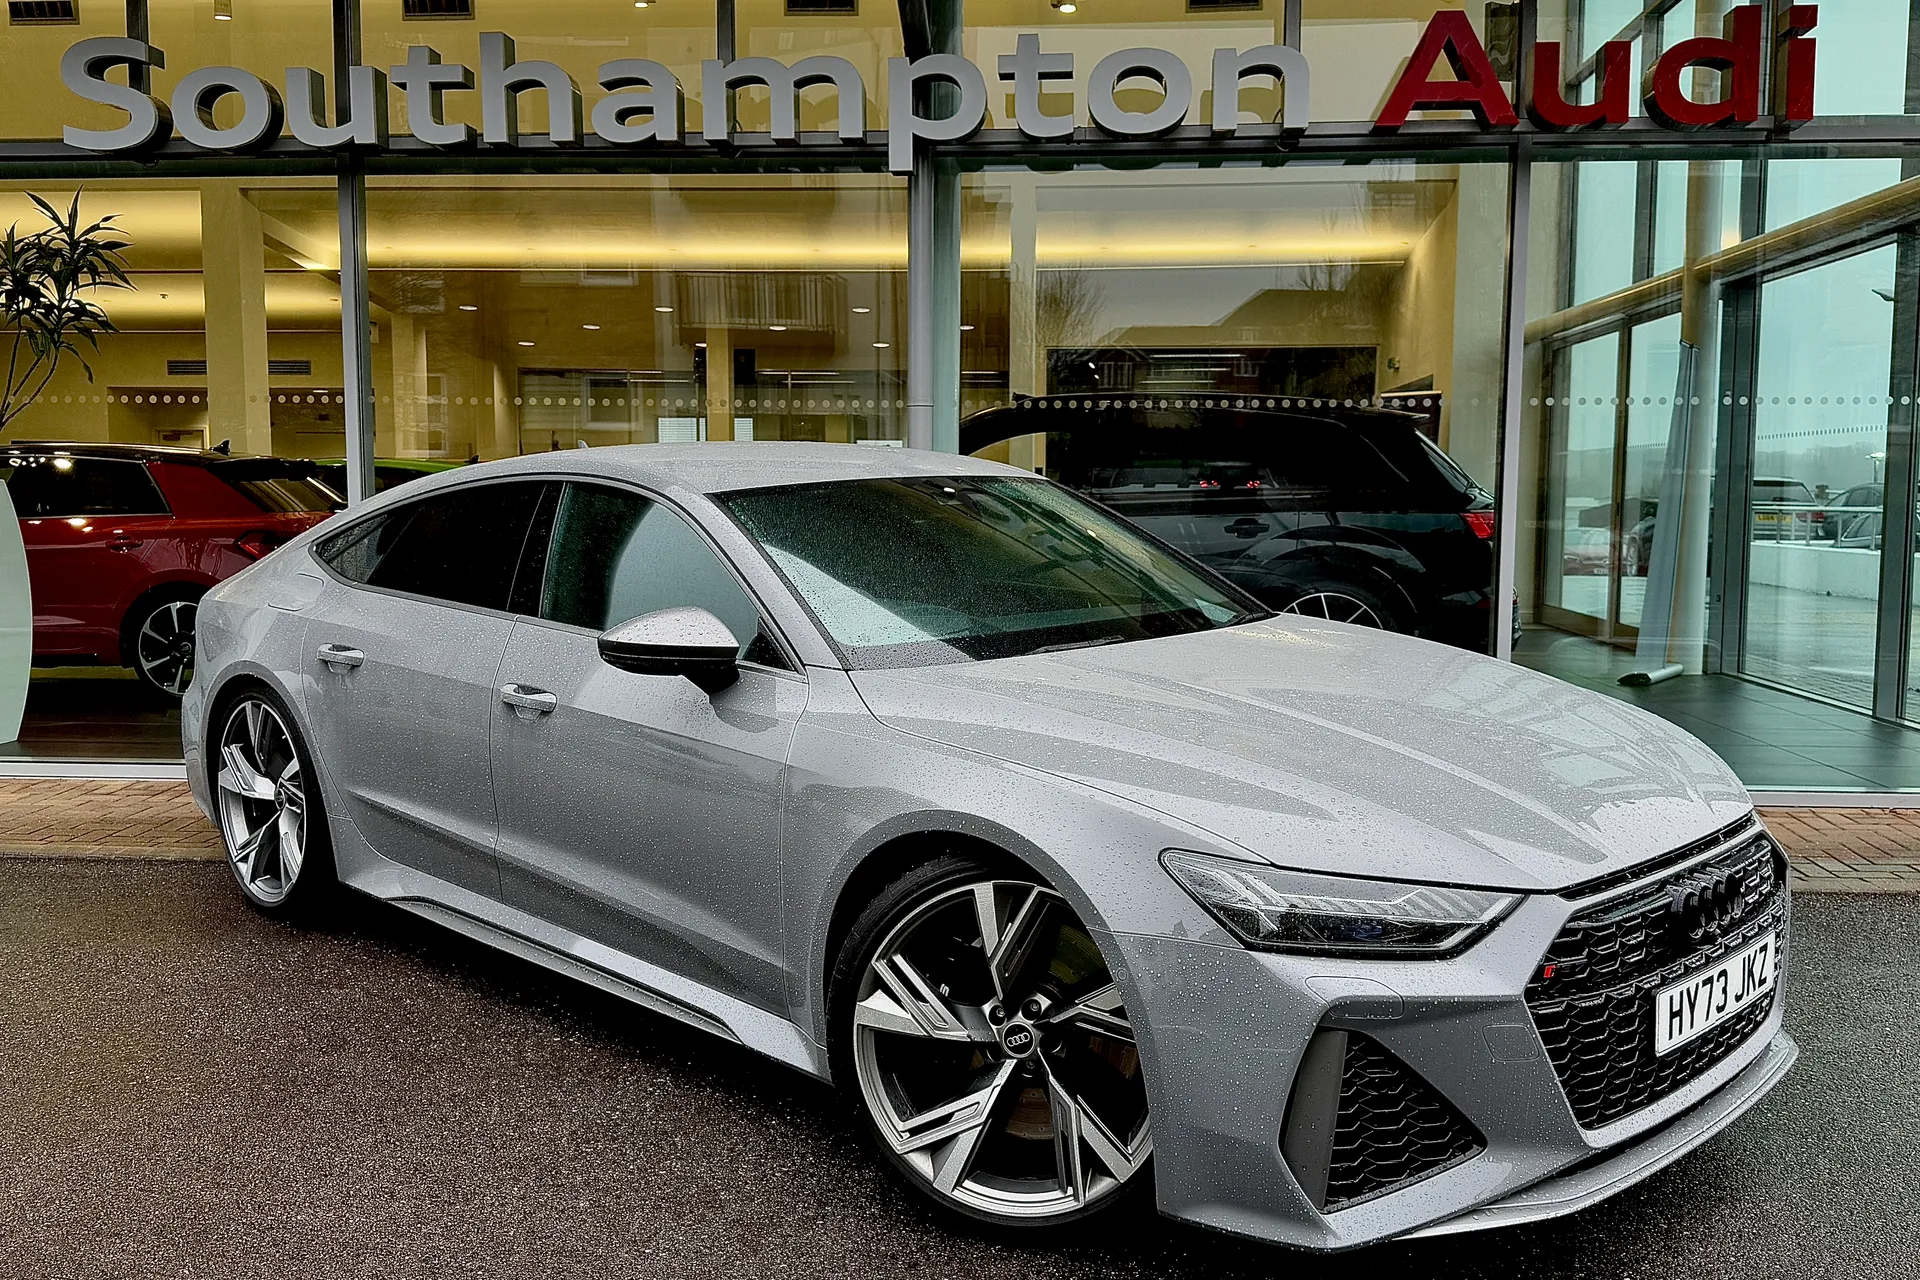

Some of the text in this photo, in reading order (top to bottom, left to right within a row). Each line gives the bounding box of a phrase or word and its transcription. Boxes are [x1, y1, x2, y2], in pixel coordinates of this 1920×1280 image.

[61, 4, 1818, 173] Southampton Audi
[1668, 941, 1769, 1041] HY73 JKZ
